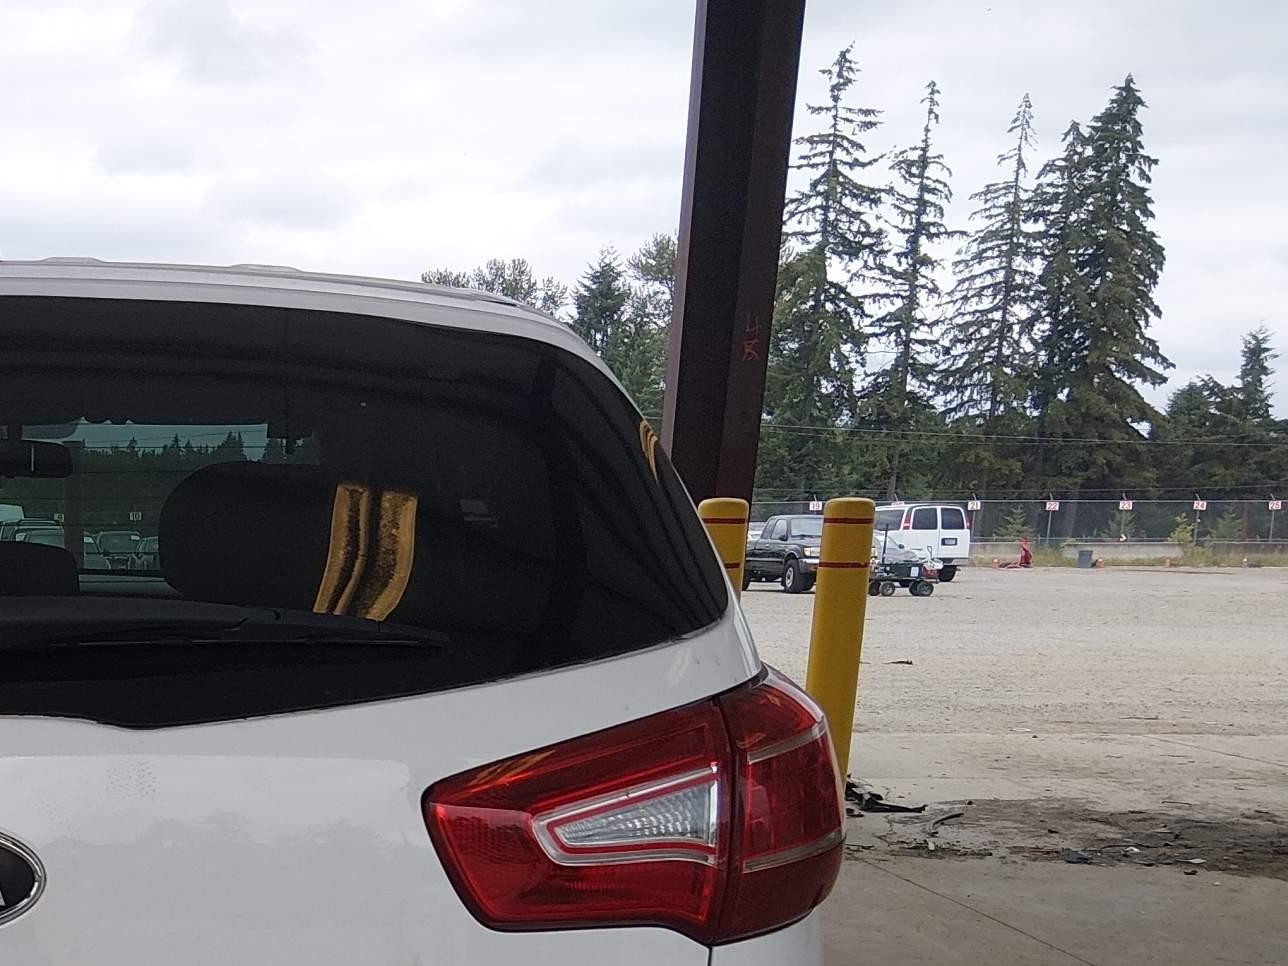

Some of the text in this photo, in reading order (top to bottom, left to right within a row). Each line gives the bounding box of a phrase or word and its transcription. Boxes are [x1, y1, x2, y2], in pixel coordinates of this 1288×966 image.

[1047, 502, 1057, 510] 22
[1120, 501, 1131, 510] 23
[1194, 501, 1205, 510] 24
[1269, 501, 1280, 510] 25
